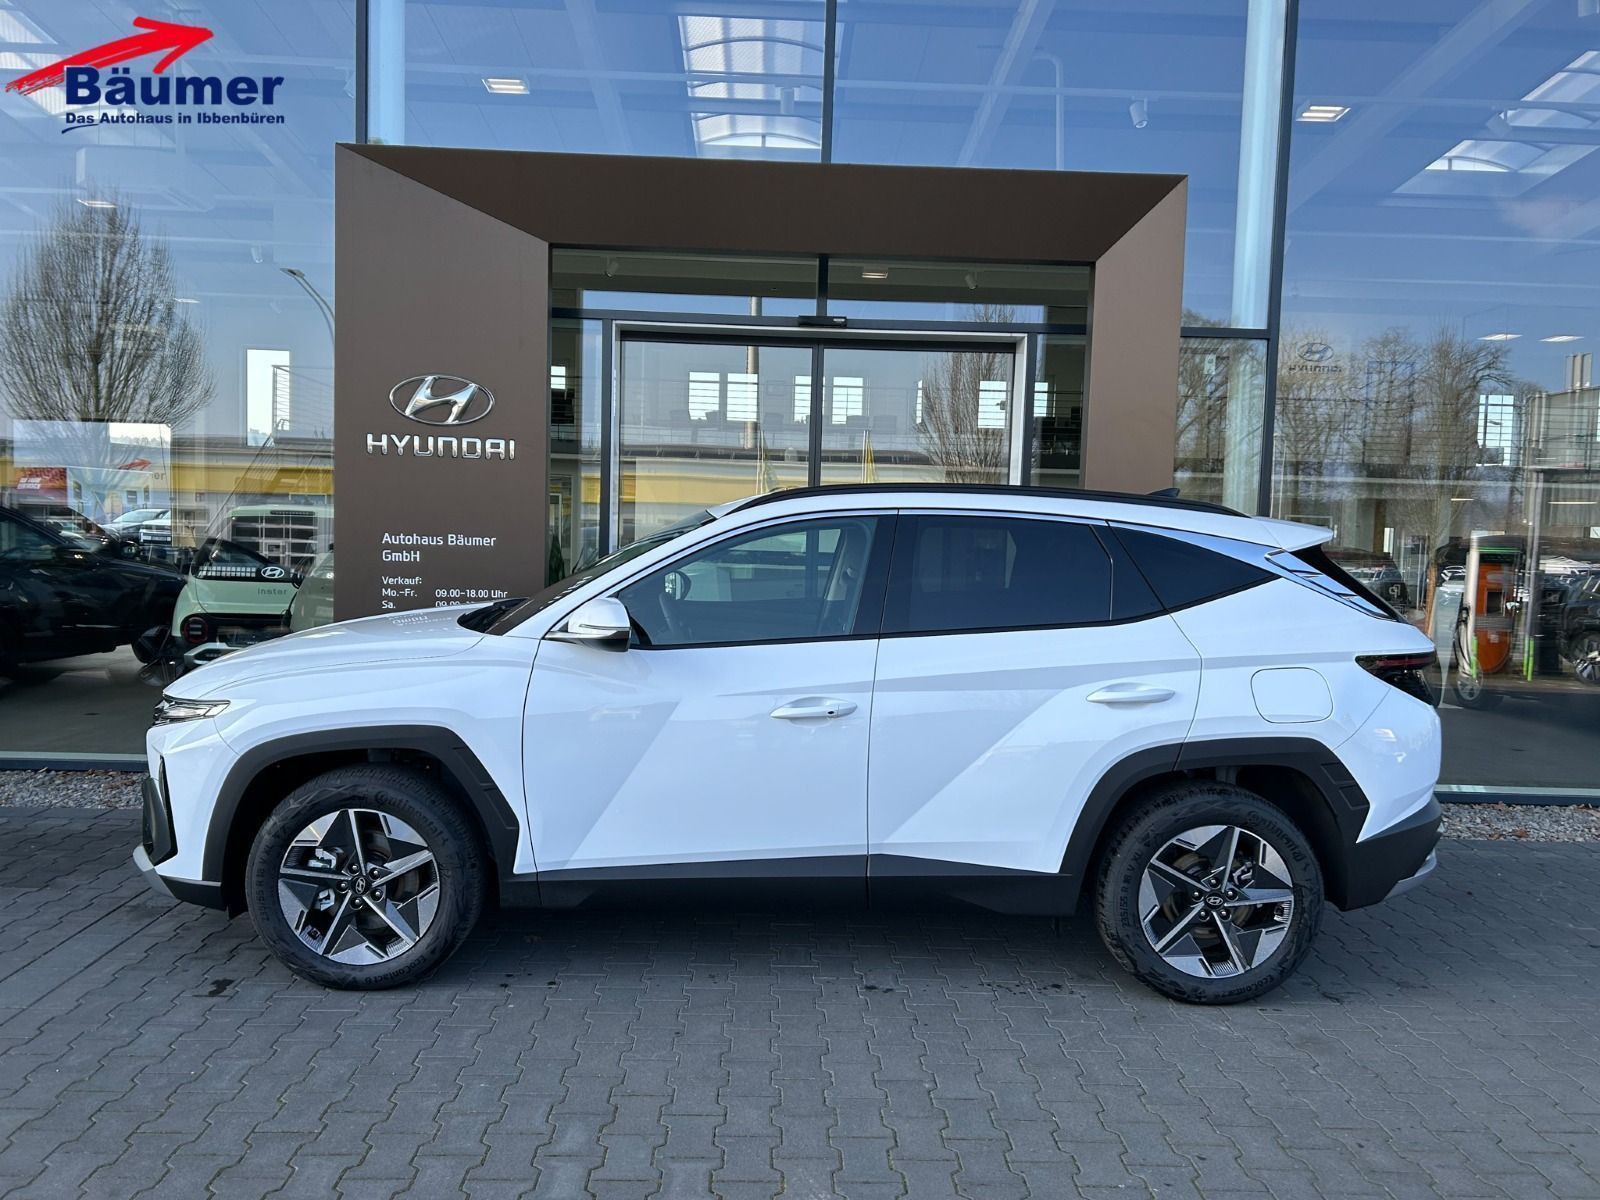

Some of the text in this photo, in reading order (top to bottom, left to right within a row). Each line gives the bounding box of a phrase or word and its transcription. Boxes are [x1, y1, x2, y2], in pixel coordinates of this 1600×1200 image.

[366, 433, 516, 460] HYUNDAI
[382, 532, 497, 547] Autohaus Bäumer
[382, 550, 420, 562] GmbH
[382, 576, 423, 585] Verkauf:
[435, 589, 489, 598] 09.00-18.00
[491, 590, 508, 598] Uhr
[382, 600, 396, 609] Sa.
